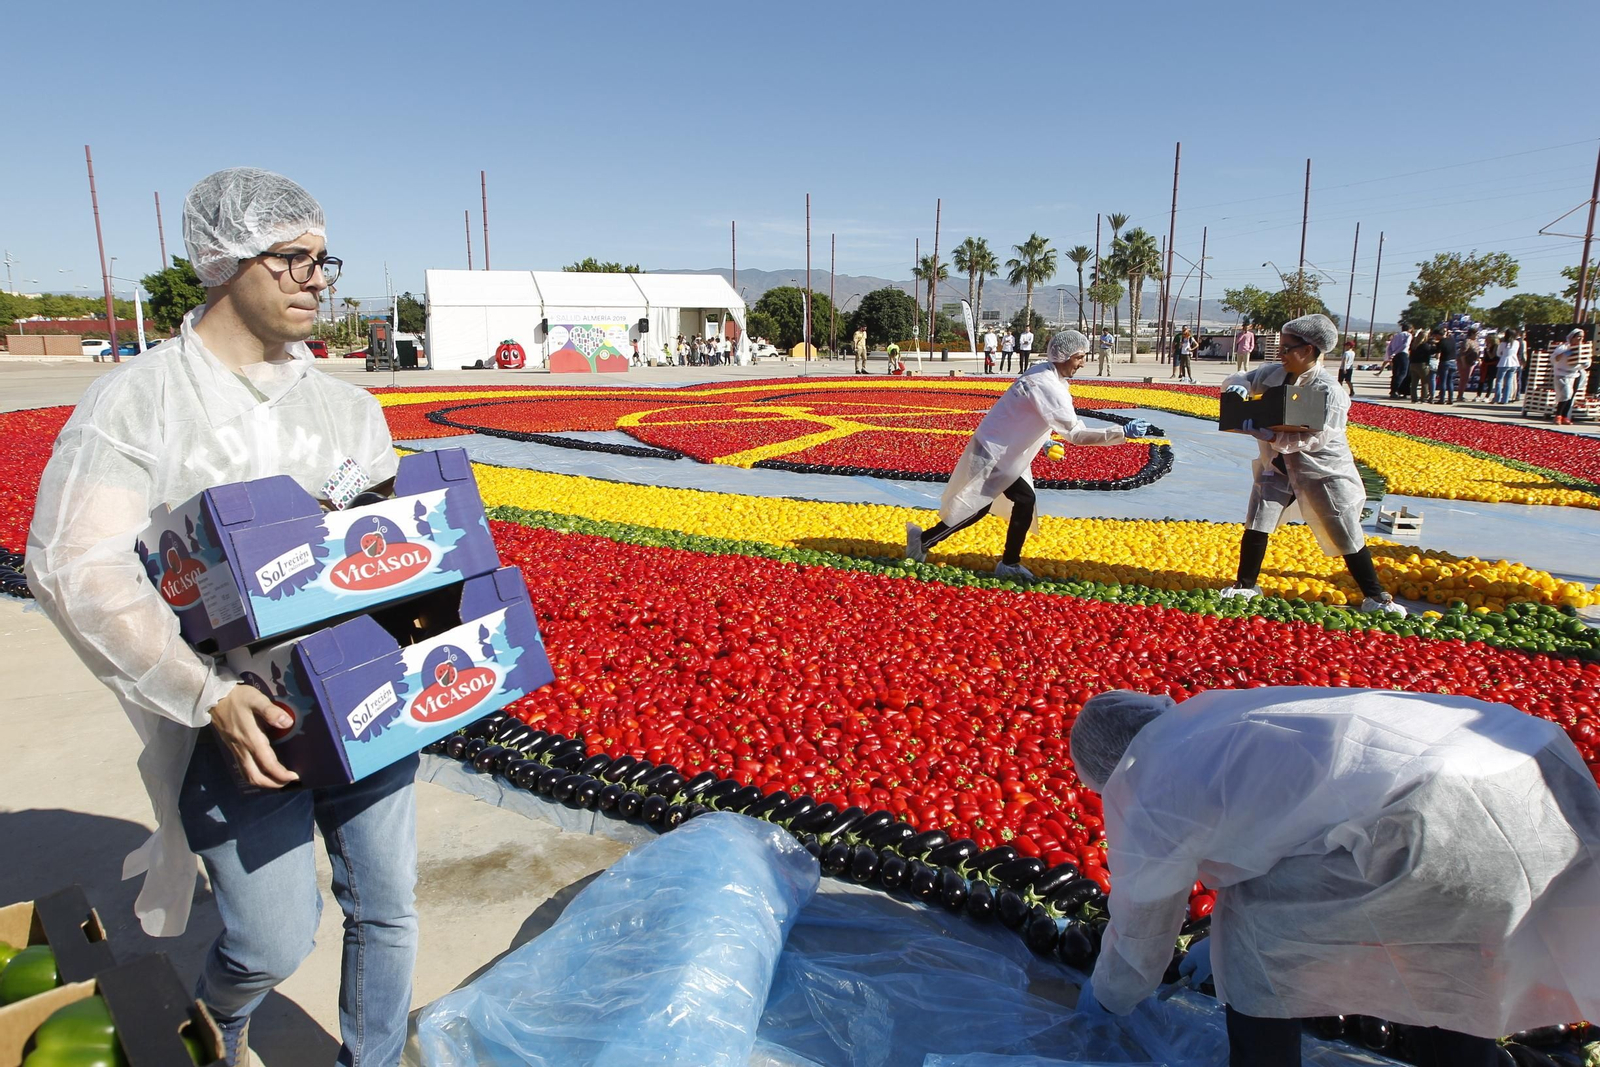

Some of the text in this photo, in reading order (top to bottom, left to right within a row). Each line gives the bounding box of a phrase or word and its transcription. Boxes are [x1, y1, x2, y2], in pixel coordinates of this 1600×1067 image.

[582, 314, 611, 322] ALMERÍA
[261, 549, 310, 588] Sol recién
[351, 703, 373, 731] Sol
[370, 687, 393, 709] recién
